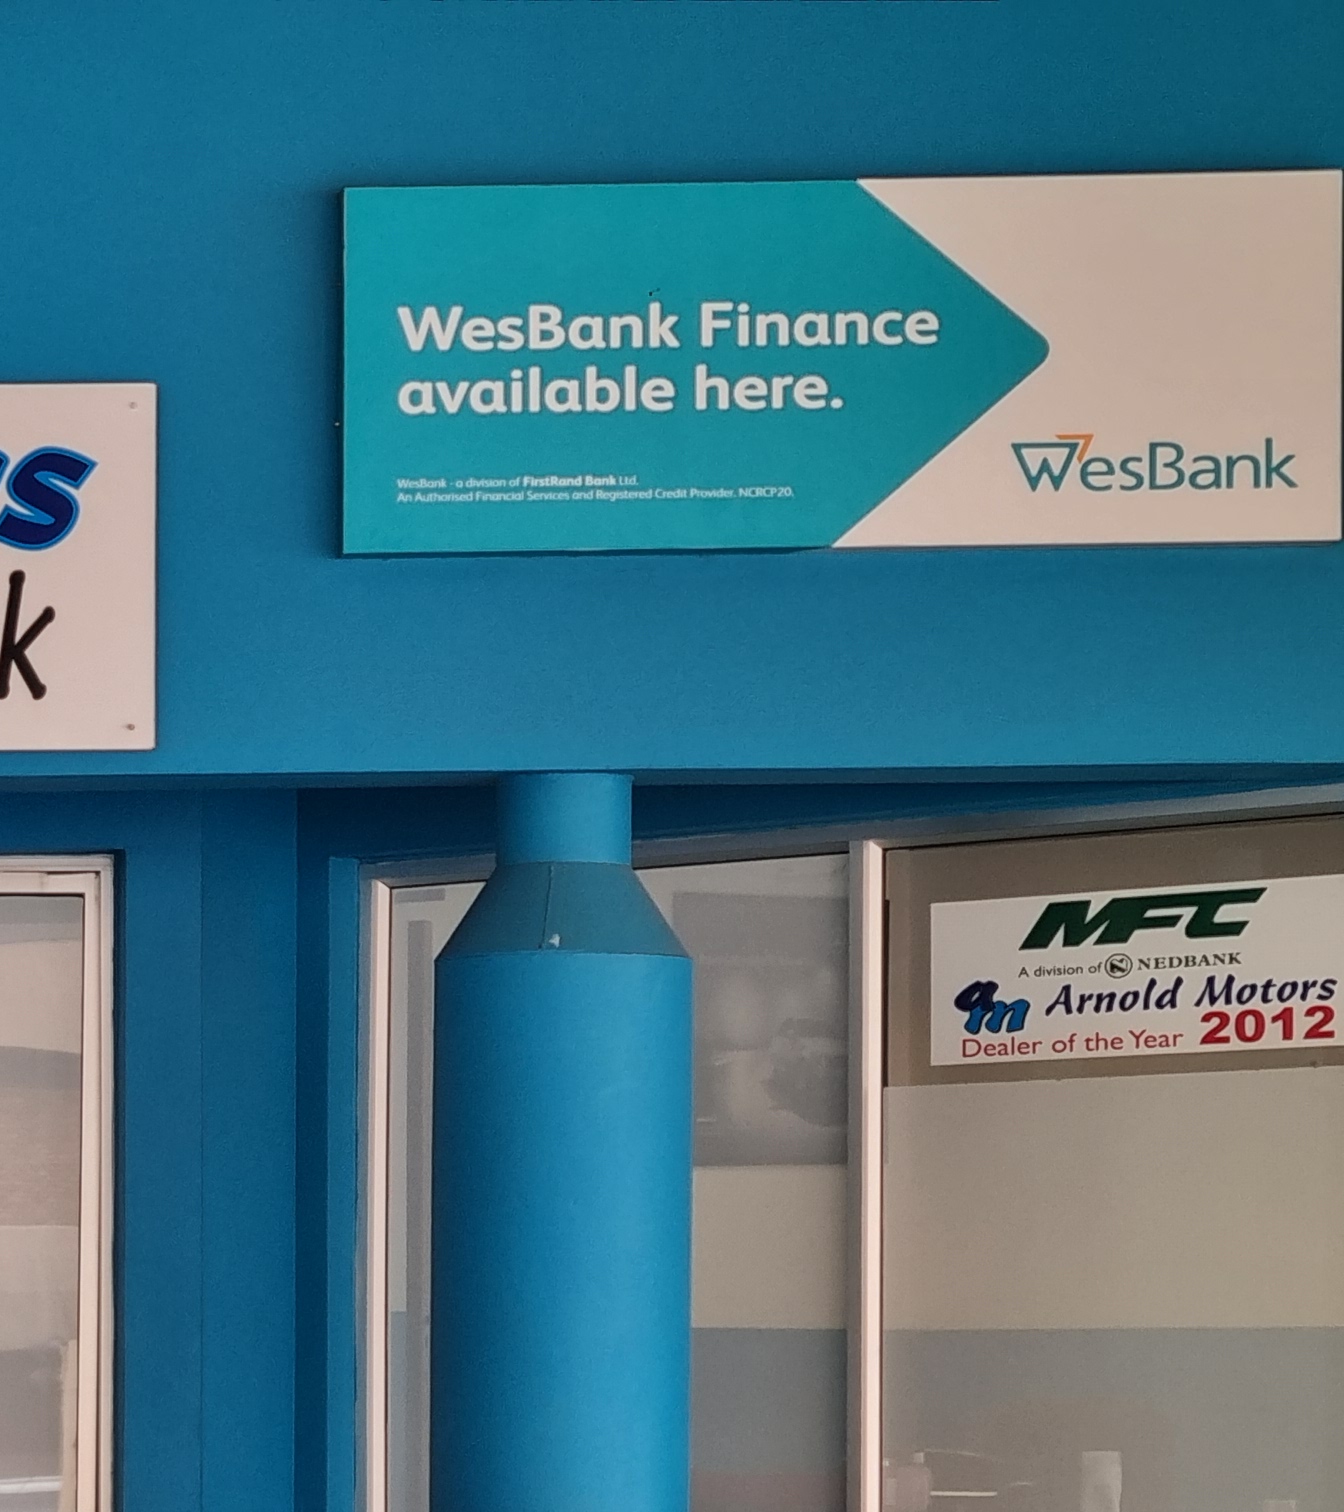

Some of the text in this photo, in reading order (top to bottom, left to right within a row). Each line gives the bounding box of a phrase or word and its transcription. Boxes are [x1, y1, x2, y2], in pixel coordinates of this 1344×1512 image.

[398, 302, 940, 352] WesBank Finance
[398, 364, 844, 416] available here.
[397, 478, 447, 489] WesBank
[465, 477, 506, 488] division
[508, 476, 521, 487] of
[523, 475, 582, 487] FirstRand
[585, 474, 616, 486] Bank
[1011, 434, 1299, 493] WesBank
[397, 492, 412, 502] An
[475, 490, 524, 501] Financial
[526, 490, 570, 501] Services
[572, 489, 594, 500] and
[596, 488, 652, 502] Registered
[655, 488, 687, 498] Credit
[1018, 887, 1268, 951] MFC
[1018, 952, 1242, 978] A division of NEDBANK
[1045, 976, 1183, 1016] Arnold
[1194, 974, 1338, 1008] Motors
[962, 1005, 1335, 1058] Dealer of the Year 2012
